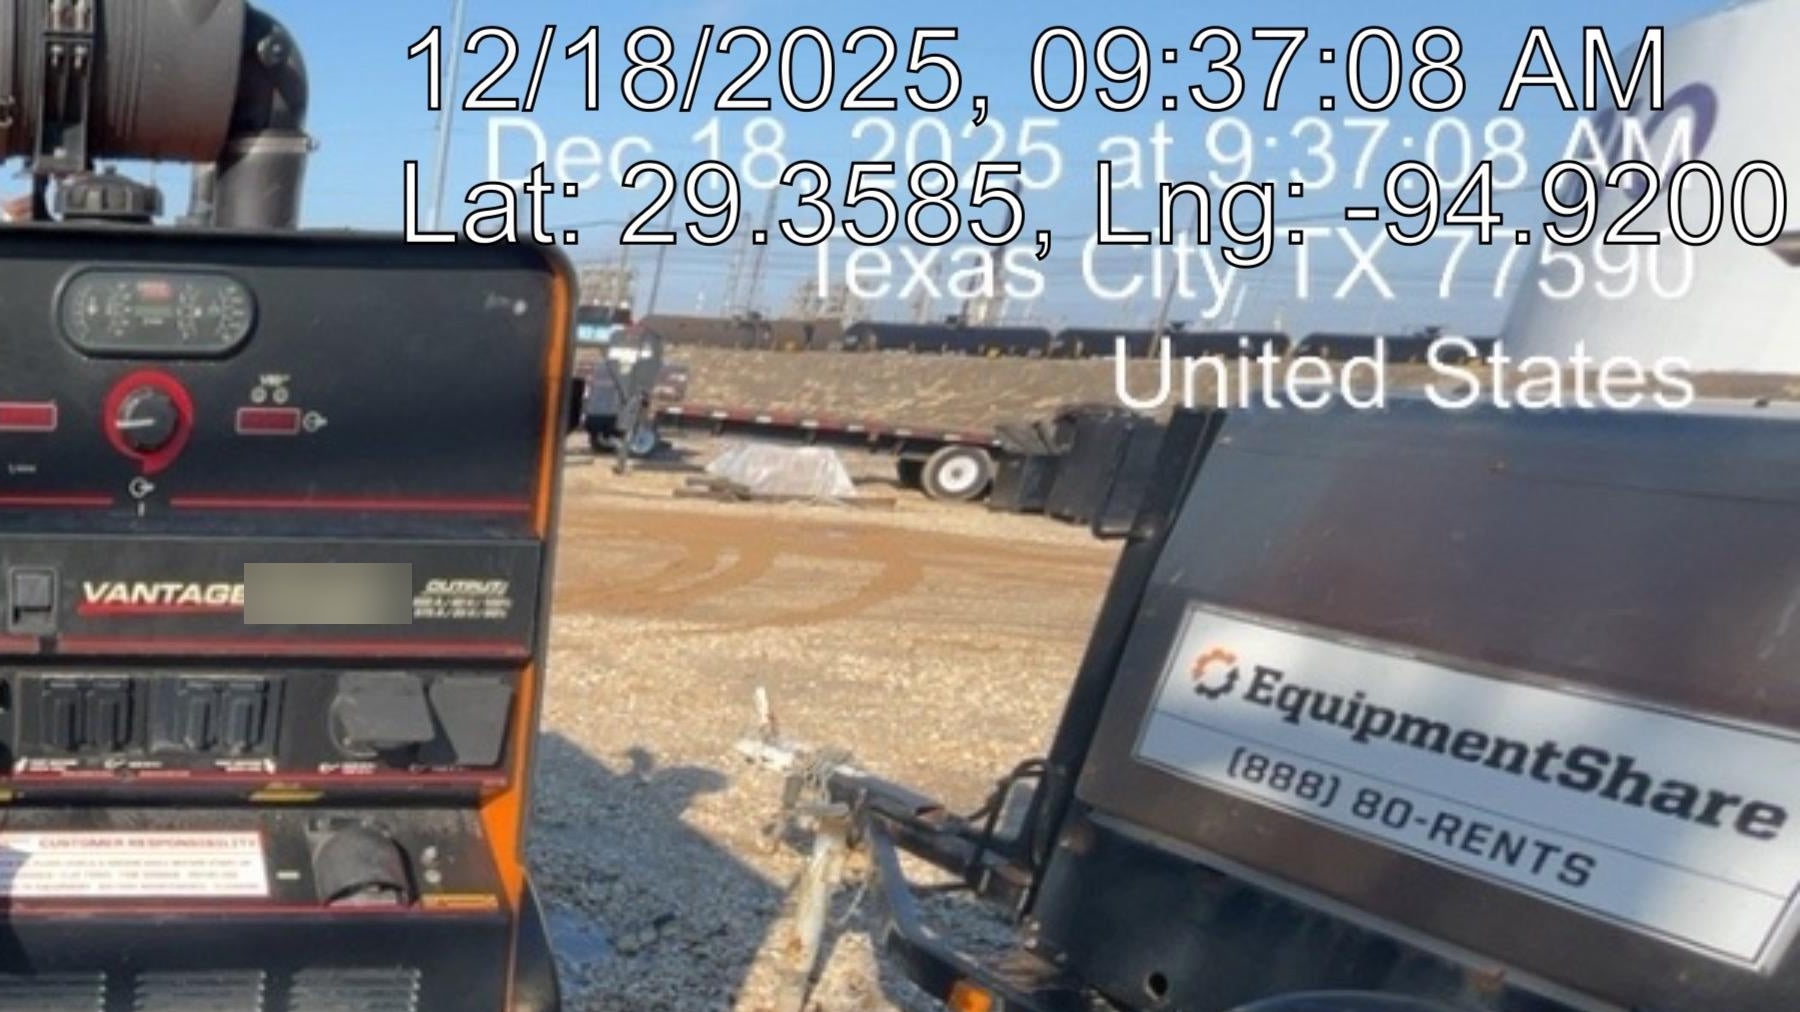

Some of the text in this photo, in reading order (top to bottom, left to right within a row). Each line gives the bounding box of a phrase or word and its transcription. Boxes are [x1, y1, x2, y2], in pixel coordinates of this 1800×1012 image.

[82, 580, 245, 605] VANTAGE
[1226, 746, 1598, 890] (888) 80-RENTS
[1242, 664, 1788, 841] EquipmentShare
